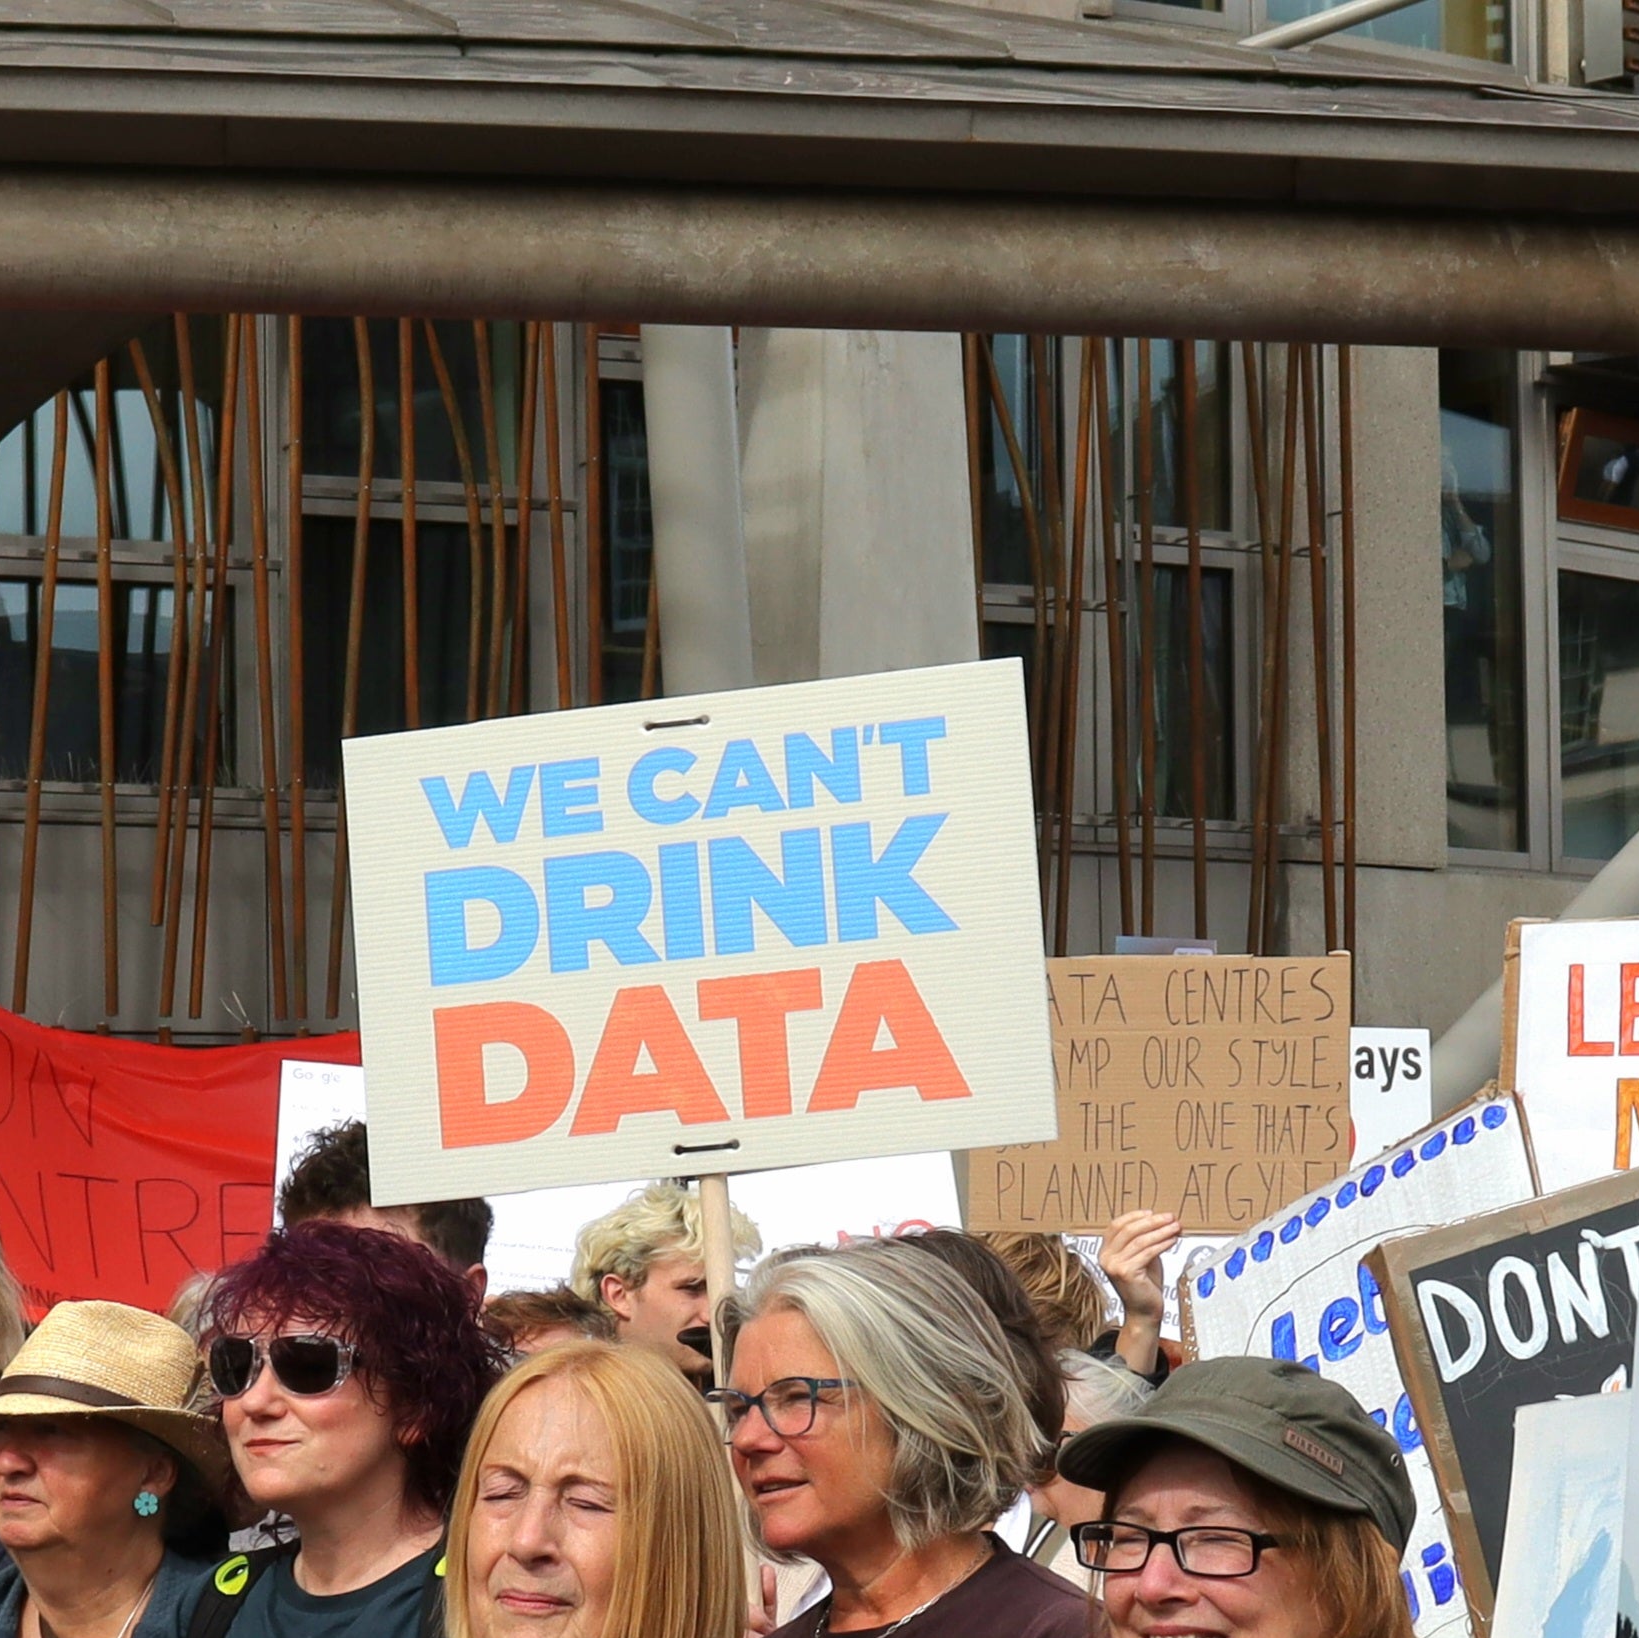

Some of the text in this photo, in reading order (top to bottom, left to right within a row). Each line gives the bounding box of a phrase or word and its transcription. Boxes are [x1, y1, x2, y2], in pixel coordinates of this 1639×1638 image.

[419, 715, 946, 849] WE CAN'T
[424, 812, 961, 987] DRINK
[1165, 967, 1335, 1026] CENTRES
[432, 958, 973, 1150] DATA
[1143, 1036, 1204, 1091] OUR
[1228, 1035, 1343, 1093] STYLE,
[1354, 1044, 1422, 1093] ays
[1080, 1100, 1341, 1155] THE ONE THAT'S
[996, 1160, 1159, 1222] PLANNED
[1178, 1163, 1218, 1222] AT
